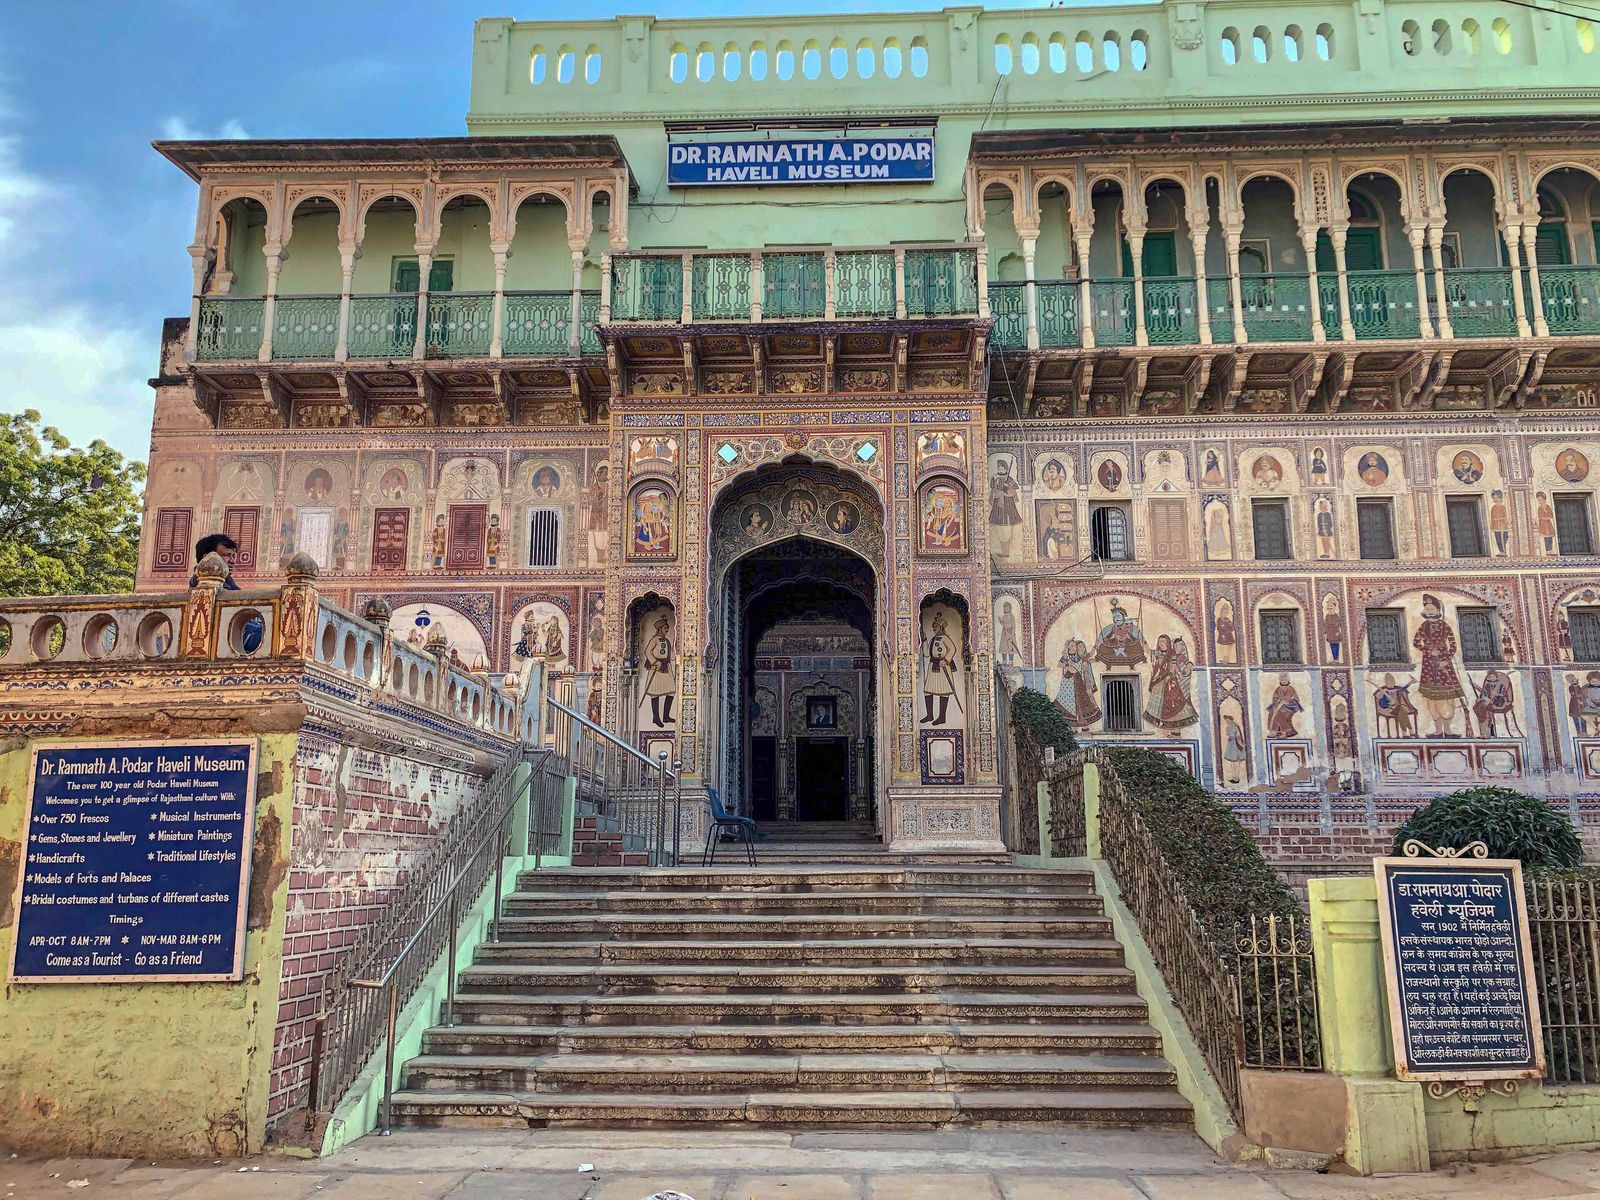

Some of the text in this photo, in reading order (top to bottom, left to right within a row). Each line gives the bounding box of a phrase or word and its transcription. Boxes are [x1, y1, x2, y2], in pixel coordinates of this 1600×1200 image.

[707, 165, 889, 181] HAVELI MUSEUM
[58, 758, 105, 775] Ramnath
[122, 756, 152, 773] Podar
[157, 756, 190, 773] Haveli
[194, 756, 245, 772] Museum
[67, 779, 218, 792] The over 100 year old Podar Haveli Museum
[46, 795, 78, 805] Welcomes
[80, 798, 92, 807] you
[95, 796, 101, 804] to
[102, 795, 114, 806] get
[123, 794, 149, 805] glimpse
[151, 794, 158, 803] of
[160, 794, 193, 805] Rajasthani
[195, 793, 218, 802] culture
[40, 813, 109, 823] Over 750 Frescos
[159, 811, 241, 822] Musical Instruments
[87, 832, 100, 842] and
[103, 831, 136, 845] Jewellery
[158, 829, 232, 843] Miniature Paintings
[36, 853, 85, 863] Handicrafts
[156, 850, 236, 863] Traditional Lifestyles
[34, 872, 151, 884] Models of Forts and Palaces
[1470, 879, 1502, 899] पोदार
[32, 892, 229, 905] Bridal costumes and turbans of different castes
[1411, 899, 1495, 920] हवेली म्यूजियम
[109, 915, 144, 926] Timings
[1438, 923, 1458, 931] 1902
[1491, 920, 1511, 933] हवेली
[30, 936, 67, 946] APR-OCT
[141, 935, 177, 945] NOV-MAR
[1454, 936, 1473, 945] भारत
[46, 953, 72, 966] Come
[72, 955, 83, 965] as
[84, 956, 90, 965] a
[92, 952, 122, 965] Tourist
[135, 952, 146, 965] Go
[149, 955, 160, 965] as
[161, 955, 167, 965] a
[170, 951, 202, 965] Friend
[1417, 947, 1425, 958] के
[1427, 950, 1447, 959] समय
[1471, 947, 1479, 958] के
[1481, 950, 1494, 959] एक
[1403, 964, 1428, 973] सदस्य
[1457, 964, 1470, 974] इस
[1472, 960, 1493, 974] हवेली
[1494, 961, 1503, 972] में
[1503, 964, 1517, 973] एक
[1471, 979, 1481, 987] पर
[1482, 979, 1495, 987] एक
[1422, 992, 1436, 1002] चल
[1438, 992, 1451, 1002] रहा
[1489, 1020, 1498, 1029] का
